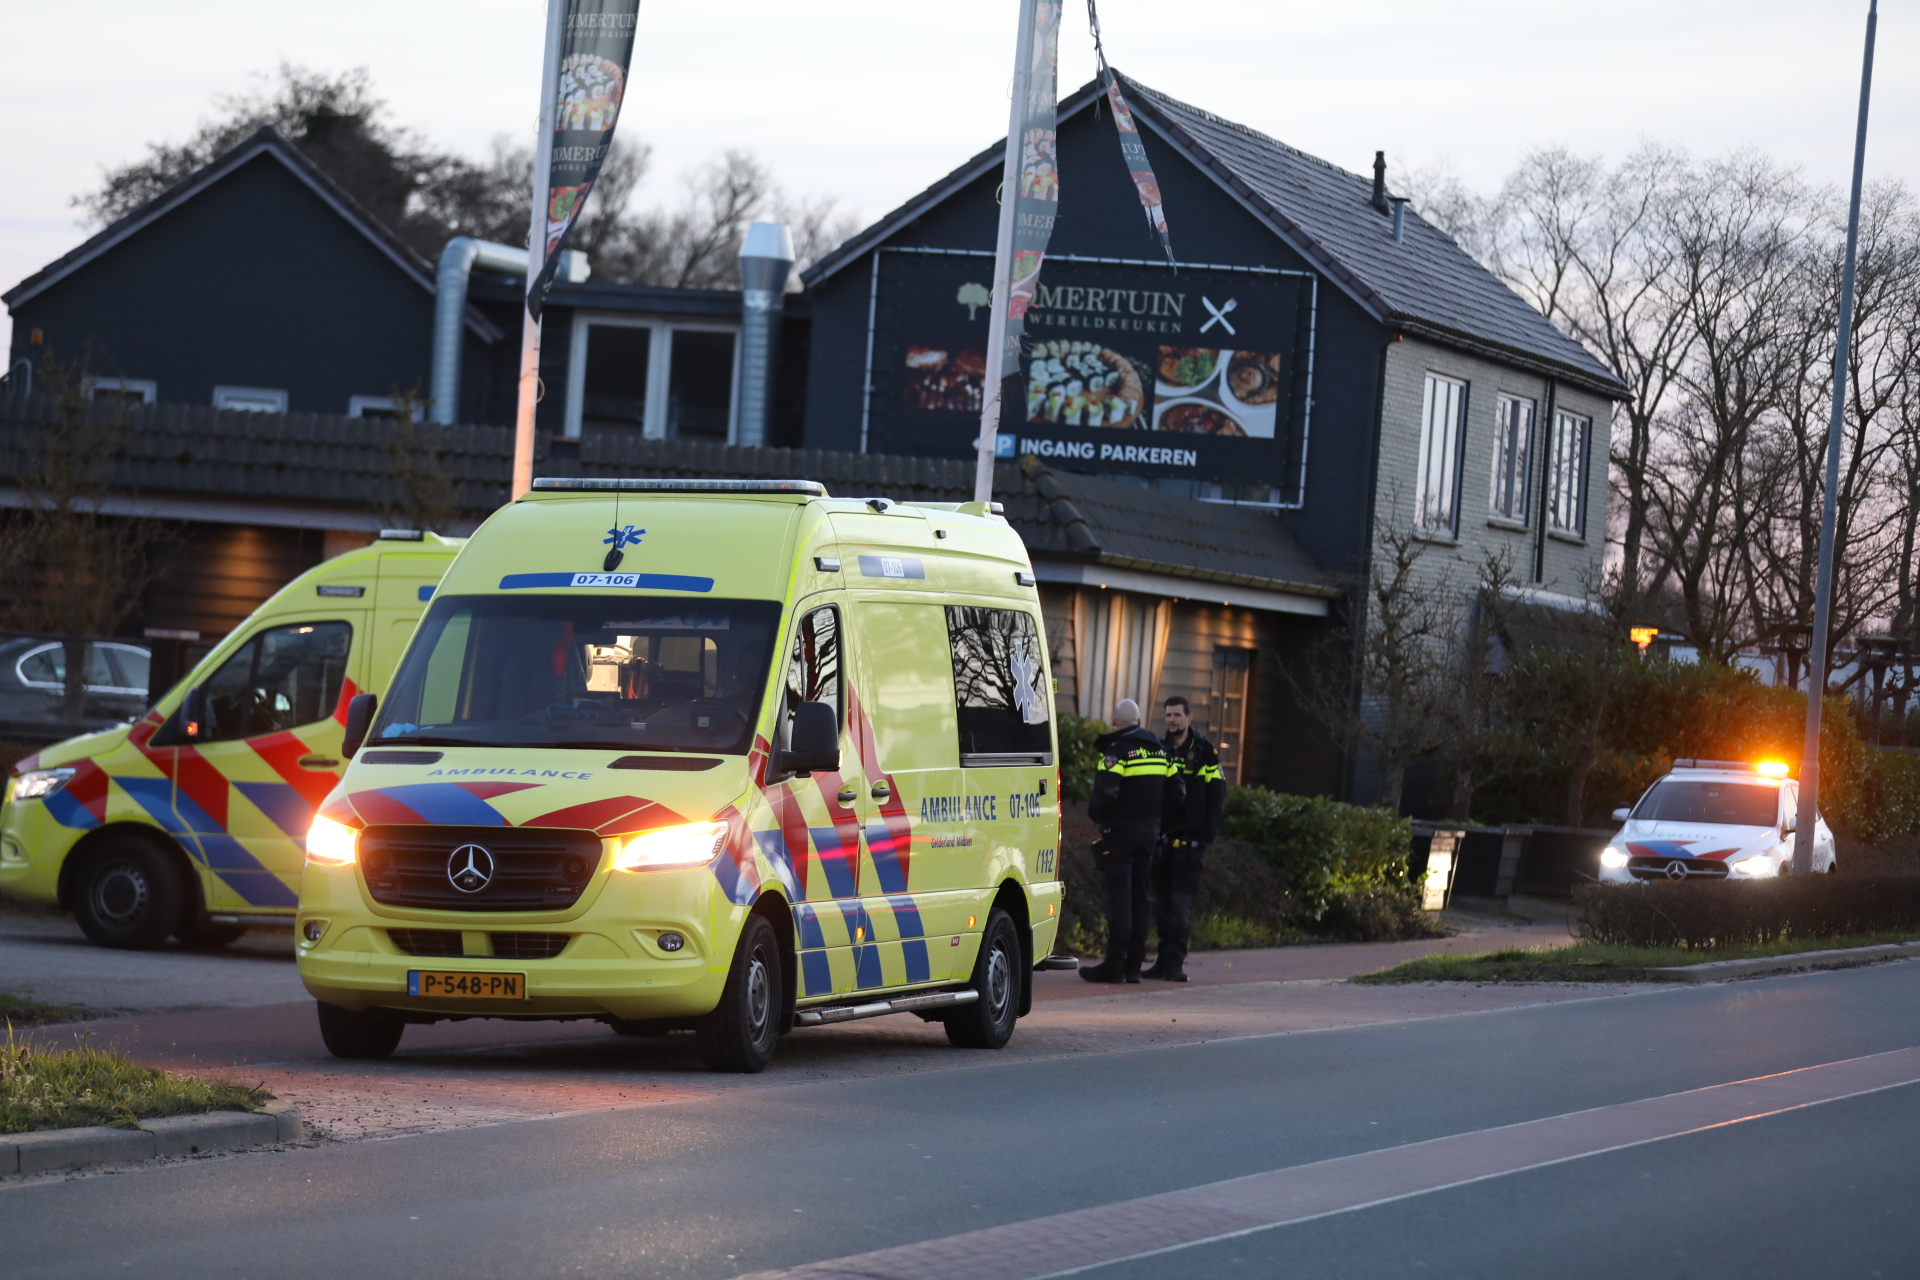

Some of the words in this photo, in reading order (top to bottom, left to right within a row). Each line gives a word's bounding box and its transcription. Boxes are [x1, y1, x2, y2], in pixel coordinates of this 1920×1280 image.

[1031, 285, 1186, 317] MERTUIN
[1029, 313, 1182, 333] WERELDKEUKEN
[1020, 438, 1095, 459] INGANG
[1100, 443, 1197, 467] PARKEREN
[577, 575, 634, 585] 07-106
[426, 768, 593, 781] AMBULANCE
[921, 795, 997, 823] AMBULANCE
[1009, 793, 1041, 819] 07-106
[425, 975, 516, 995] P-548-PN
